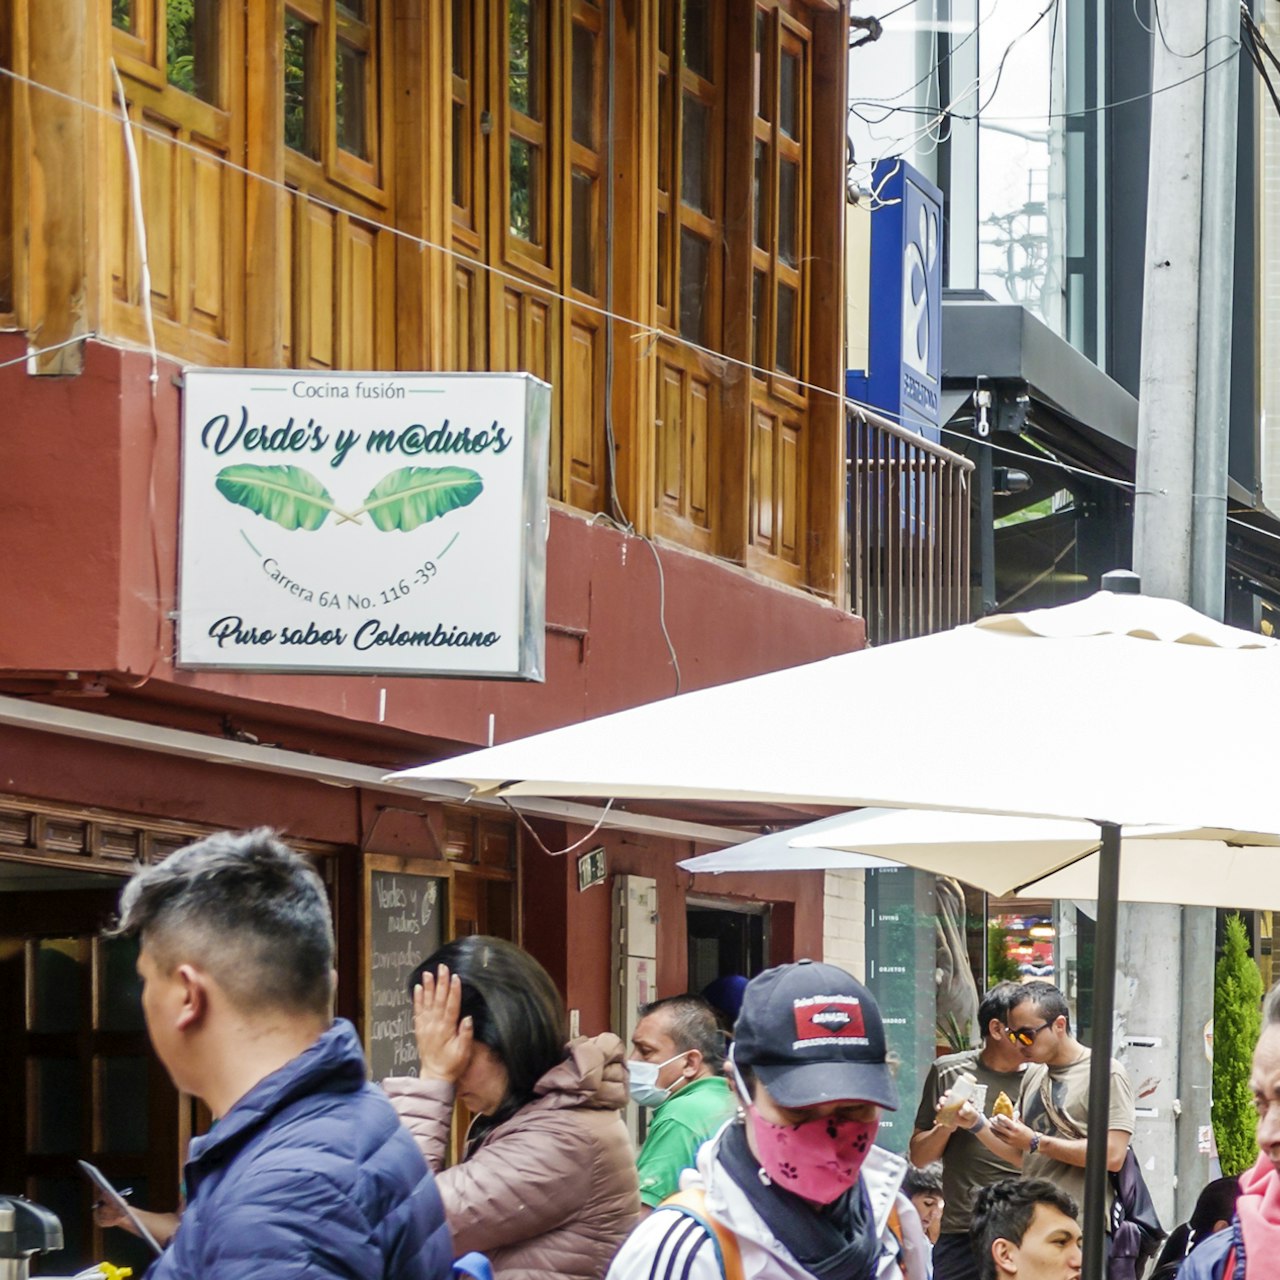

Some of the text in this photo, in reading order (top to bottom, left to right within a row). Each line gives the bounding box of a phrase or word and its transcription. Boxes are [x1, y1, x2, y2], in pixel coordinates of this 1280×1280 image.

[293, 381, 406, 400] Cocina fusión
[201, 406, 513, 468] Verde's y m@duro's
[262, 557, 314, 603] Carrera
[318, 592, 342, 610] 6A
[347, 594, 377, 610] No.
[380, 578, 411, 606] 116
[208, 616, 501, 651] Puro sabor Colombiano
